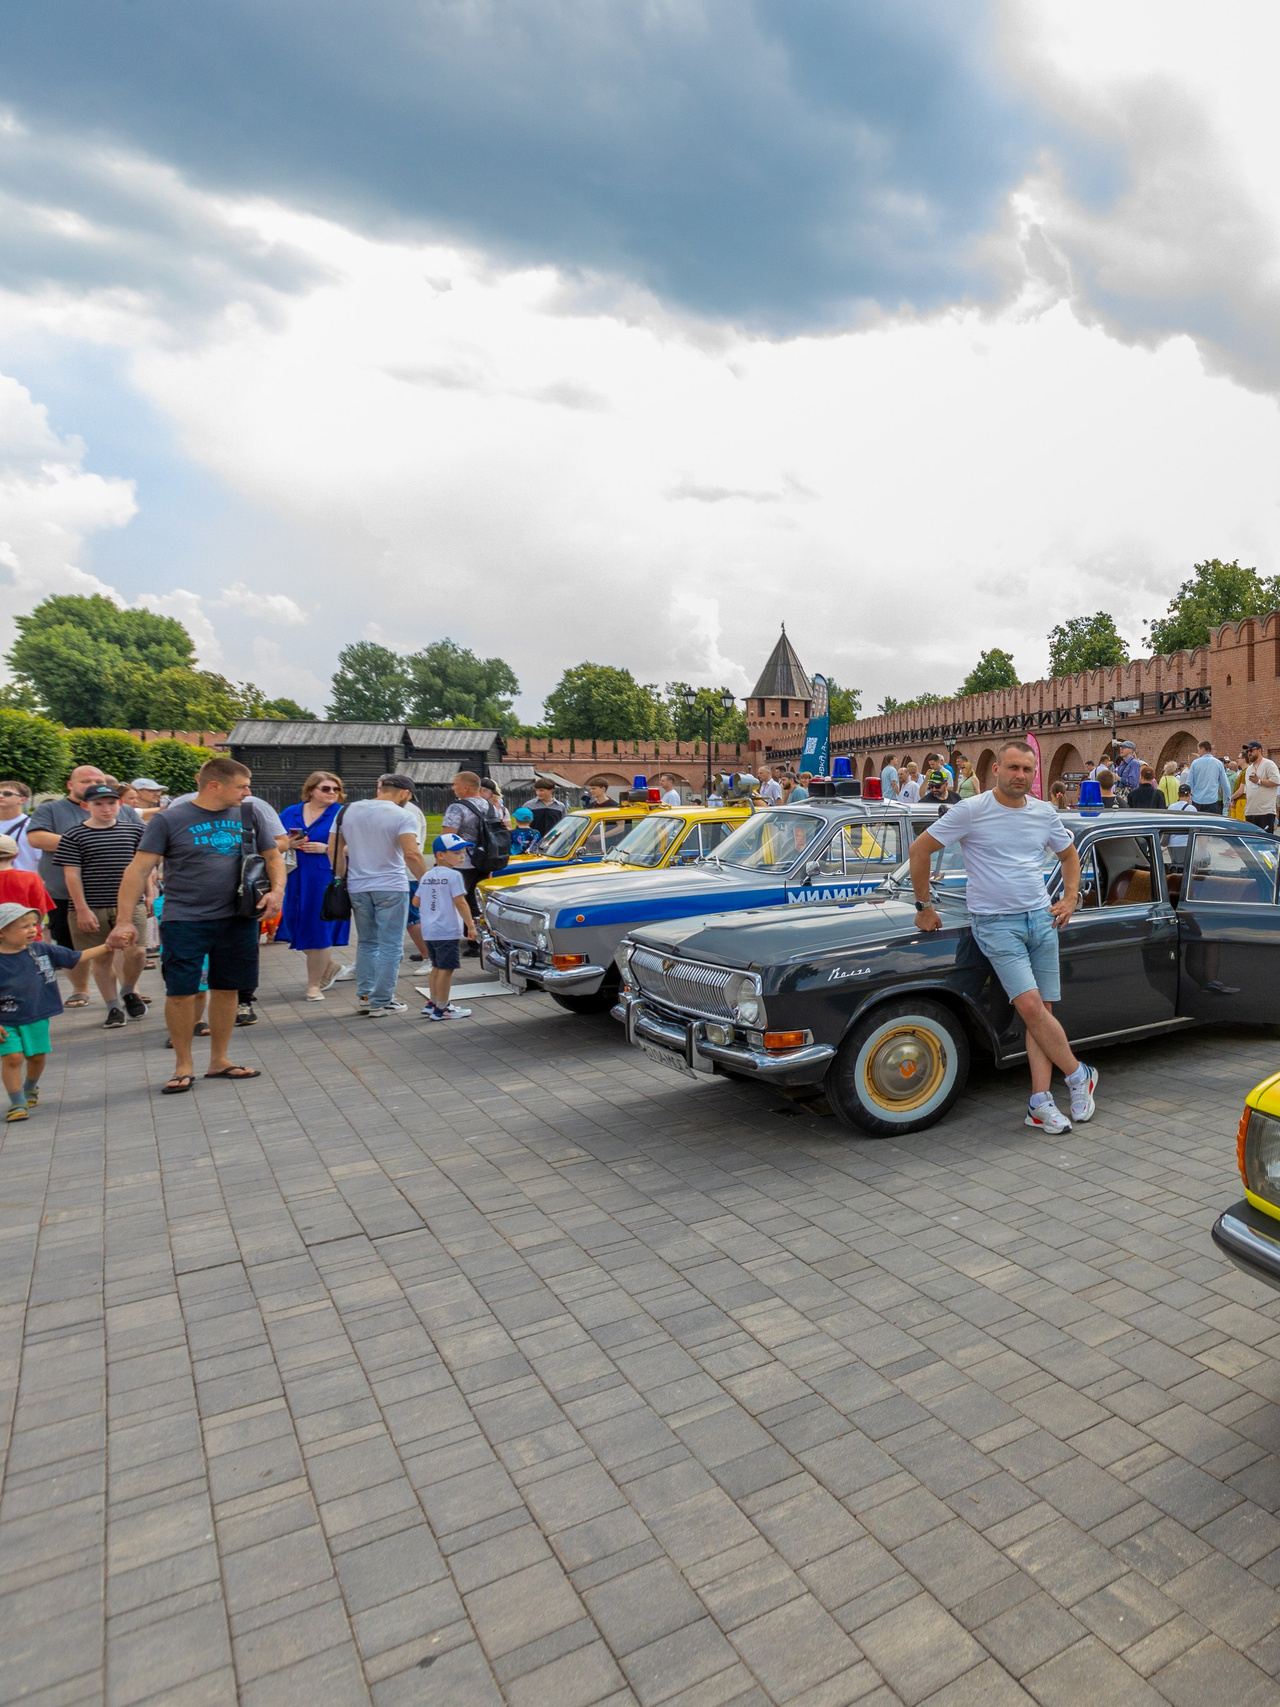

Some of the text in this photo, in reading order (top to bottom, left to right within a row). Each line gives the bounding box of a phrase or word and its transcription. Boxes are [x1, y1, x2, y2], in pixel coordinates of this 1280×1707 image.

[188, 820, 243, 834] TOM TAILO
[787, 887, 873, 904] МИЛИЦИ
